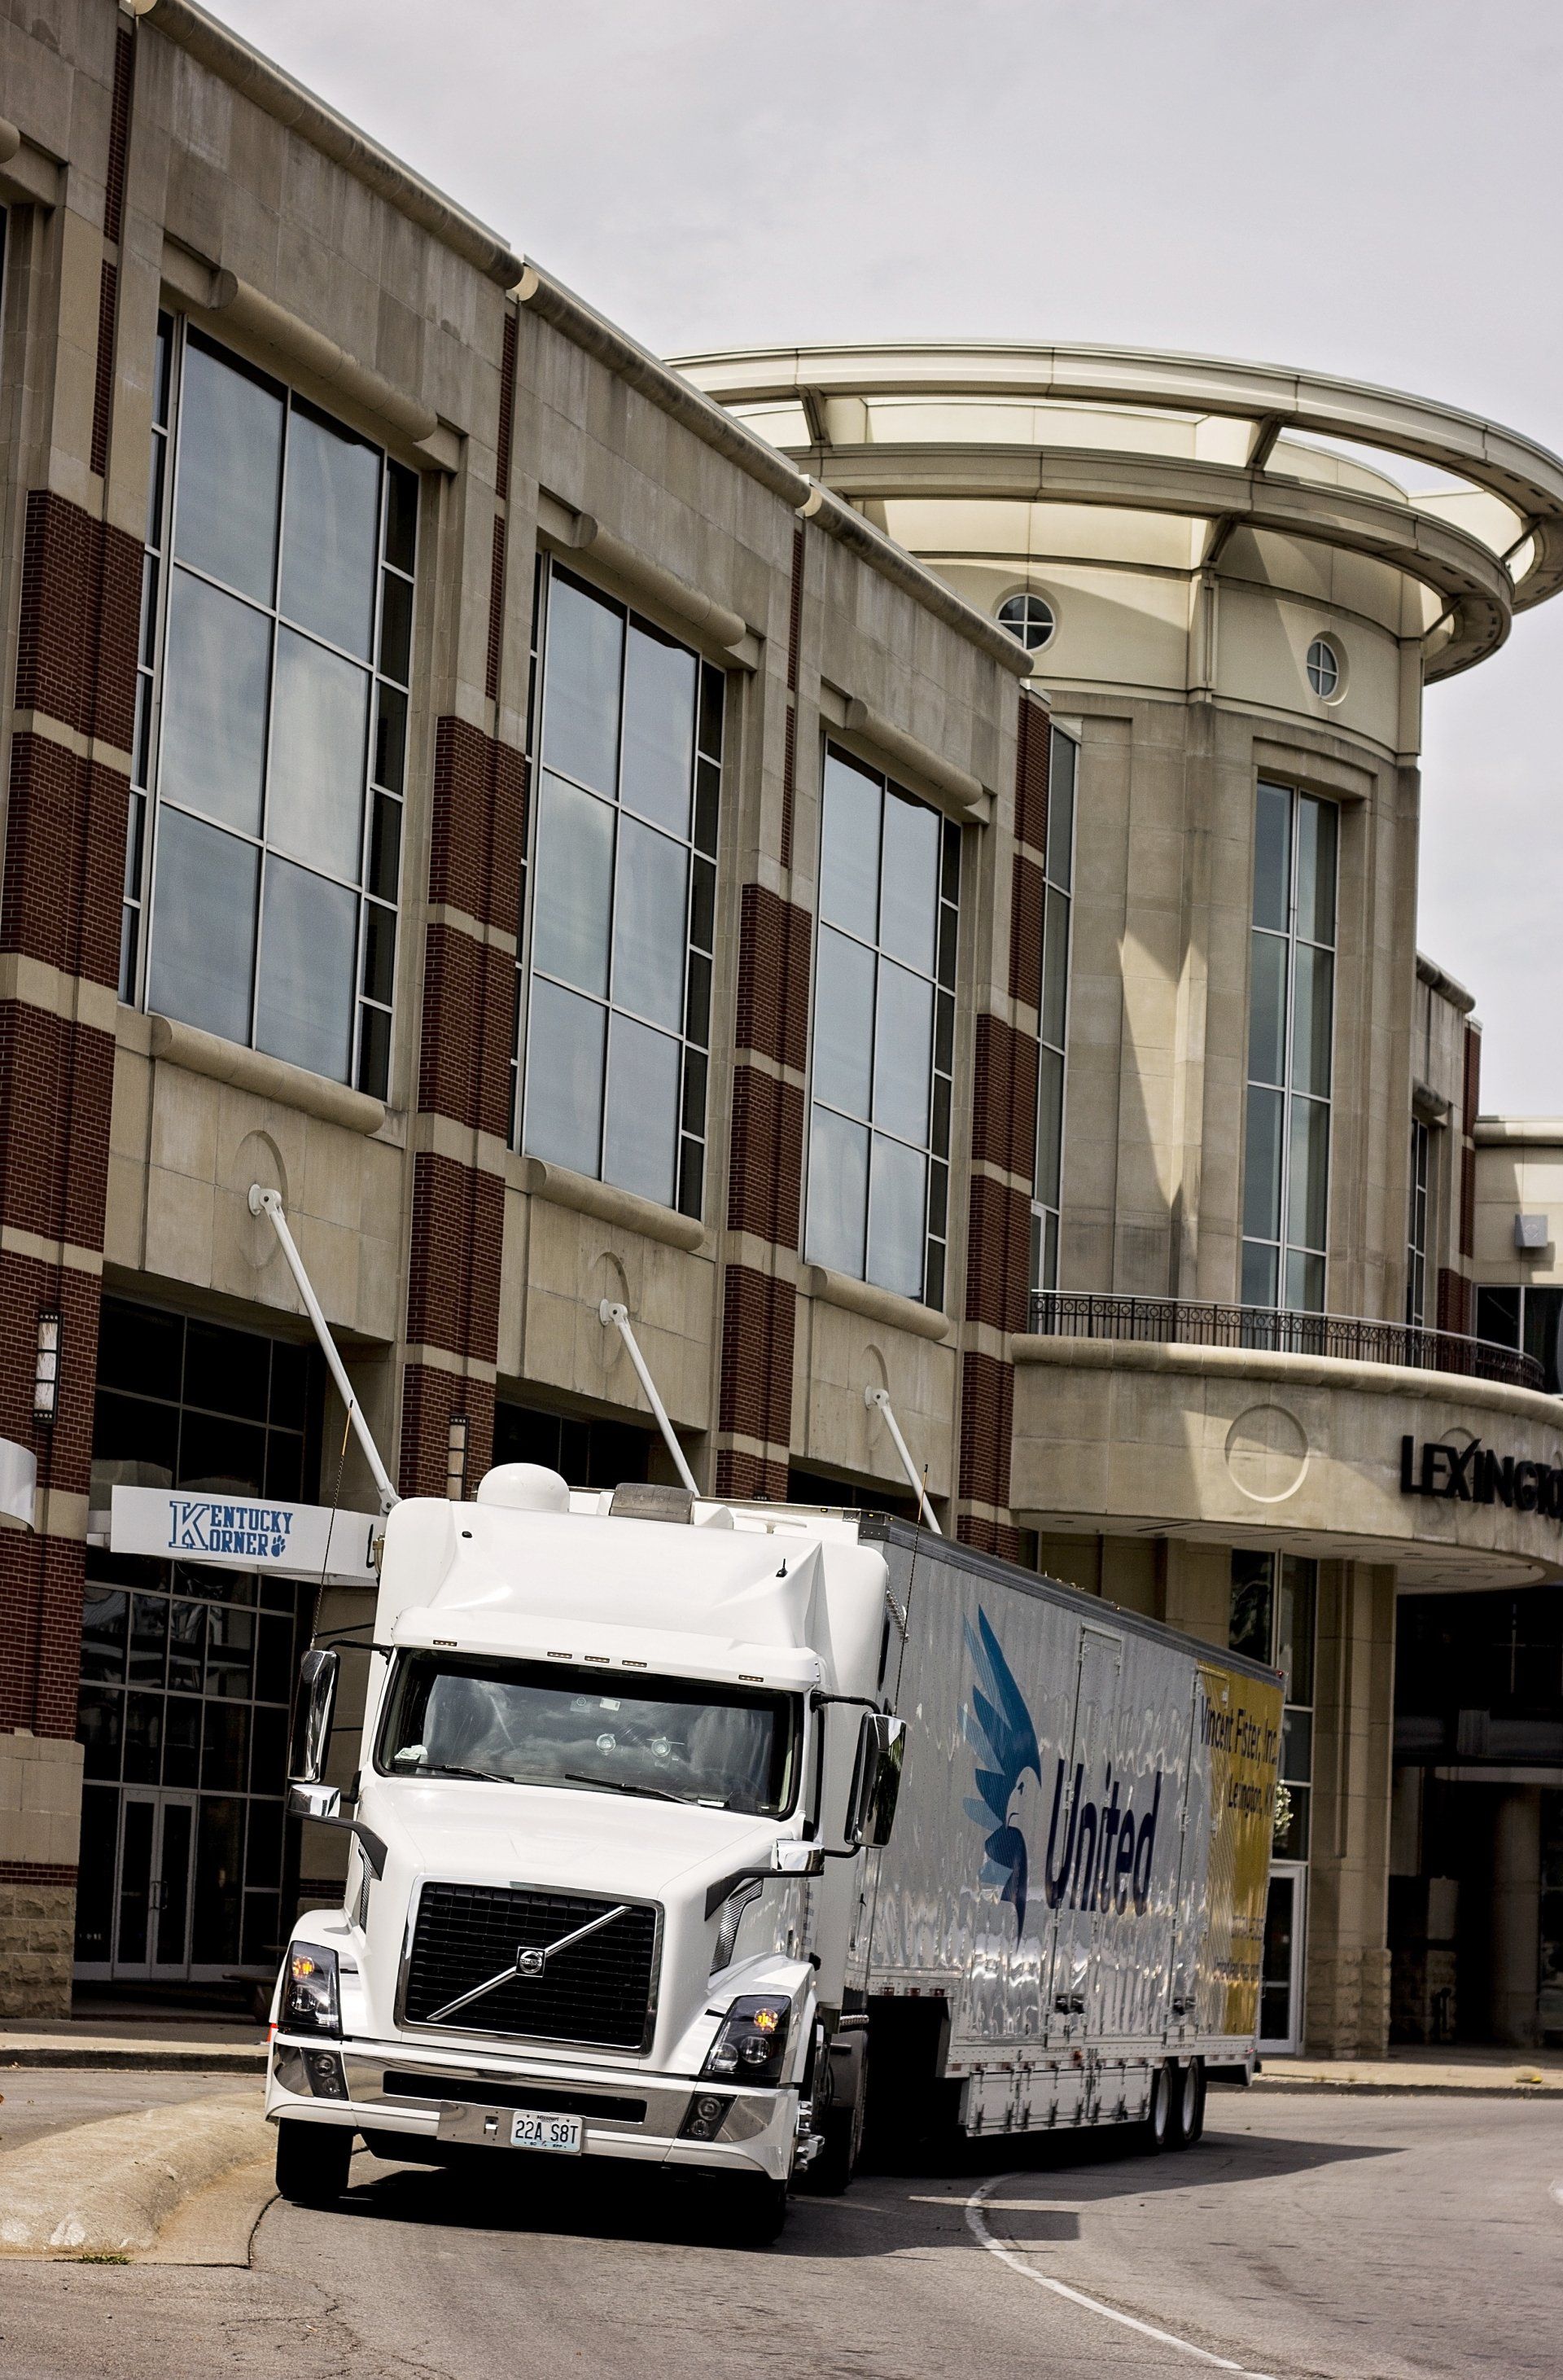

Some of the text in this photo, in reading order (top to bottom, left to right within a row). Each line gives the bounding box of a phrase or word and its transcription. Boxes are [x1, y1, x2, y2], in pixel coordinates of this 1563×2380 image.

[169, 1501, 293, 1550] KENTUCKY
[1201, 1695, 1234, 1753] Vincent
[1045, 1759, 1162, 1918] United
[515, 2119, 579, 2144] 22A S8T
